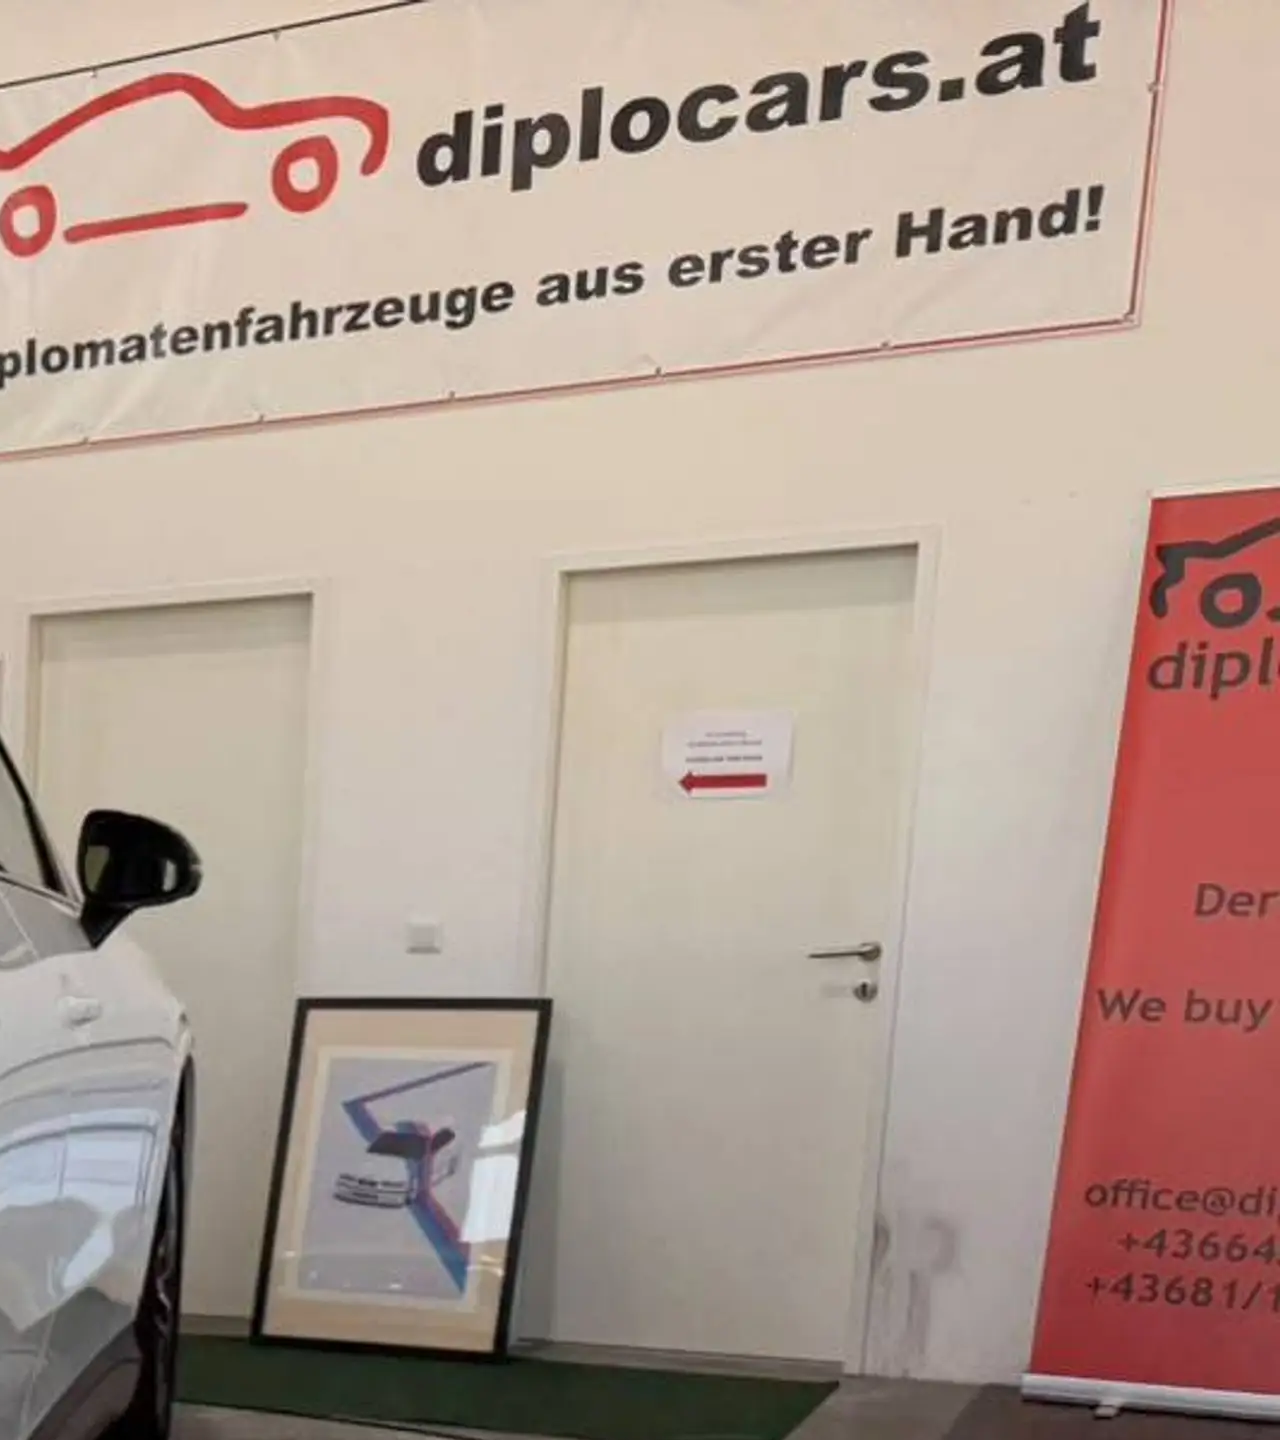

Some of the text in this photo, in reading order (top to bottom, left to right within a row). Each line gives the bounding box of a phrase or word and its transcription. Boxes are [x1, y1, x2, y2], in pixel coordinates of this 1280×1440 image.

[416, 2, 1102, 192] diplocars.at
[535, 257, 645, 310] aus
[667, 220, 871, 288] erster
[893, 184, 1106, 259] Hand!
[1148, 636, 1280, 701] dipl
[1194, 882, 1280, 918] Der
[1097, 988, 1273, 1032] We buy
[1084, 1177, 1280, 1222] office@di
[1117, 1227, 1280, 1268] +43664
